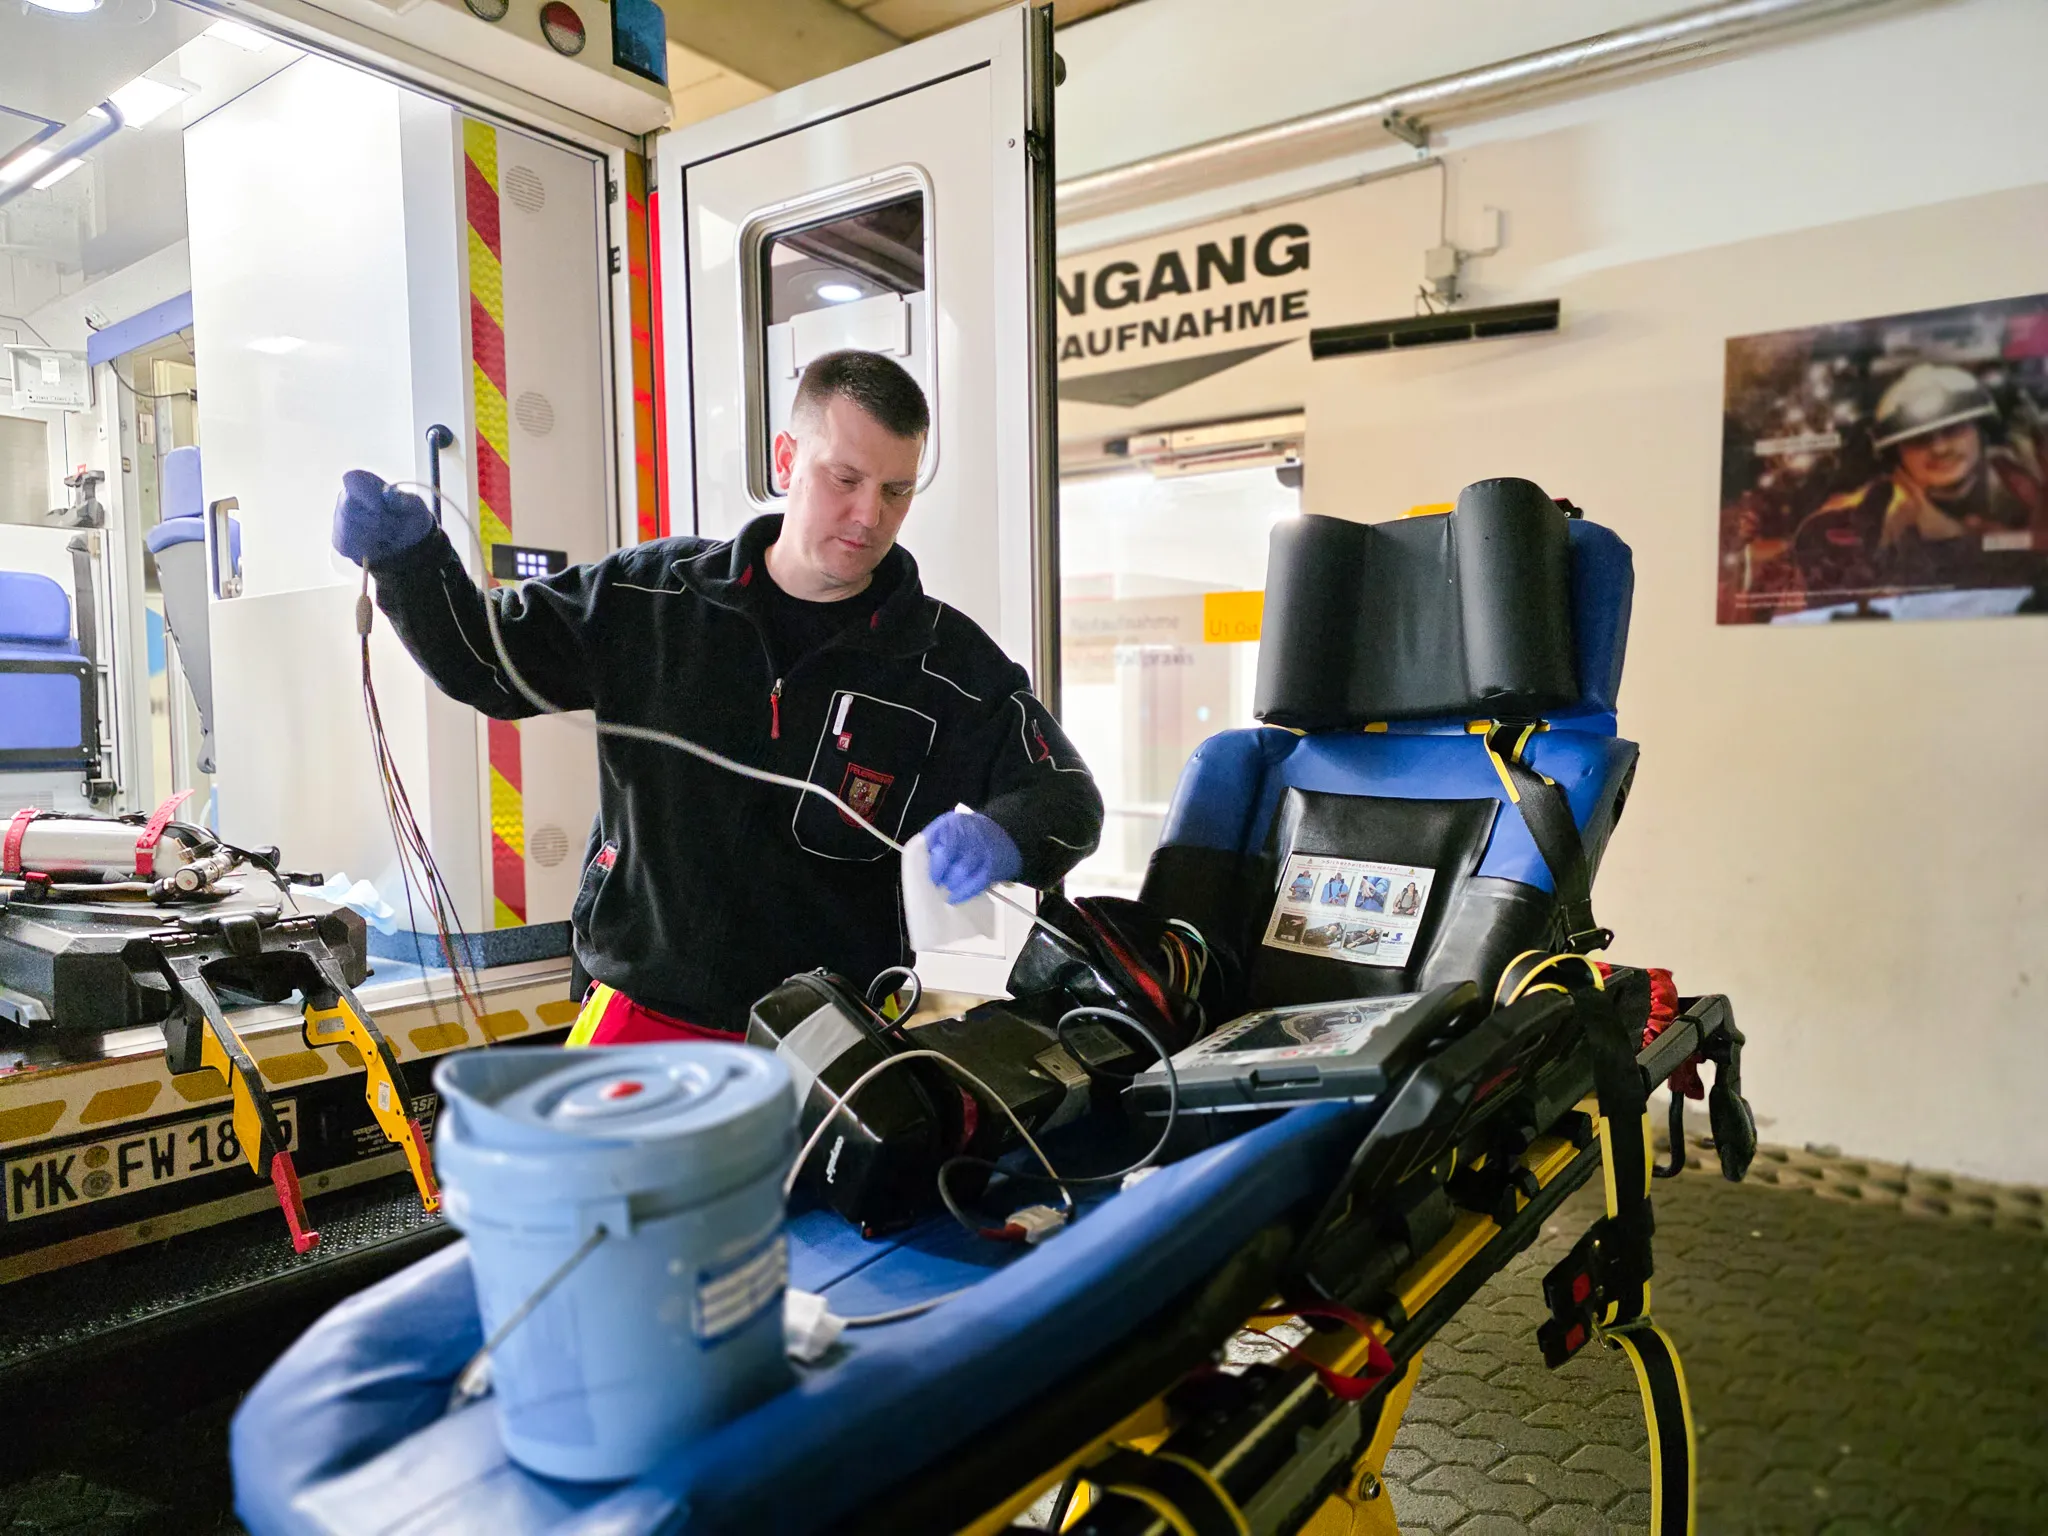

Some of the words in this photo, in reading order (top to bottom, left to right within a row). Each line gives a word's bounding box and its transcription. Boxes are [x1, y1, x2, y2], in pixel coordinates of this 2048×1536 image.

[1056, 223, 1310, 317] NGANG
[1056, 290, 1309, 362] AUFNAHME
[12, 1153, 78, 1214] MK
[118, 1132, 176, 1188] FW
[188, 1106, 293, 1171] 185
